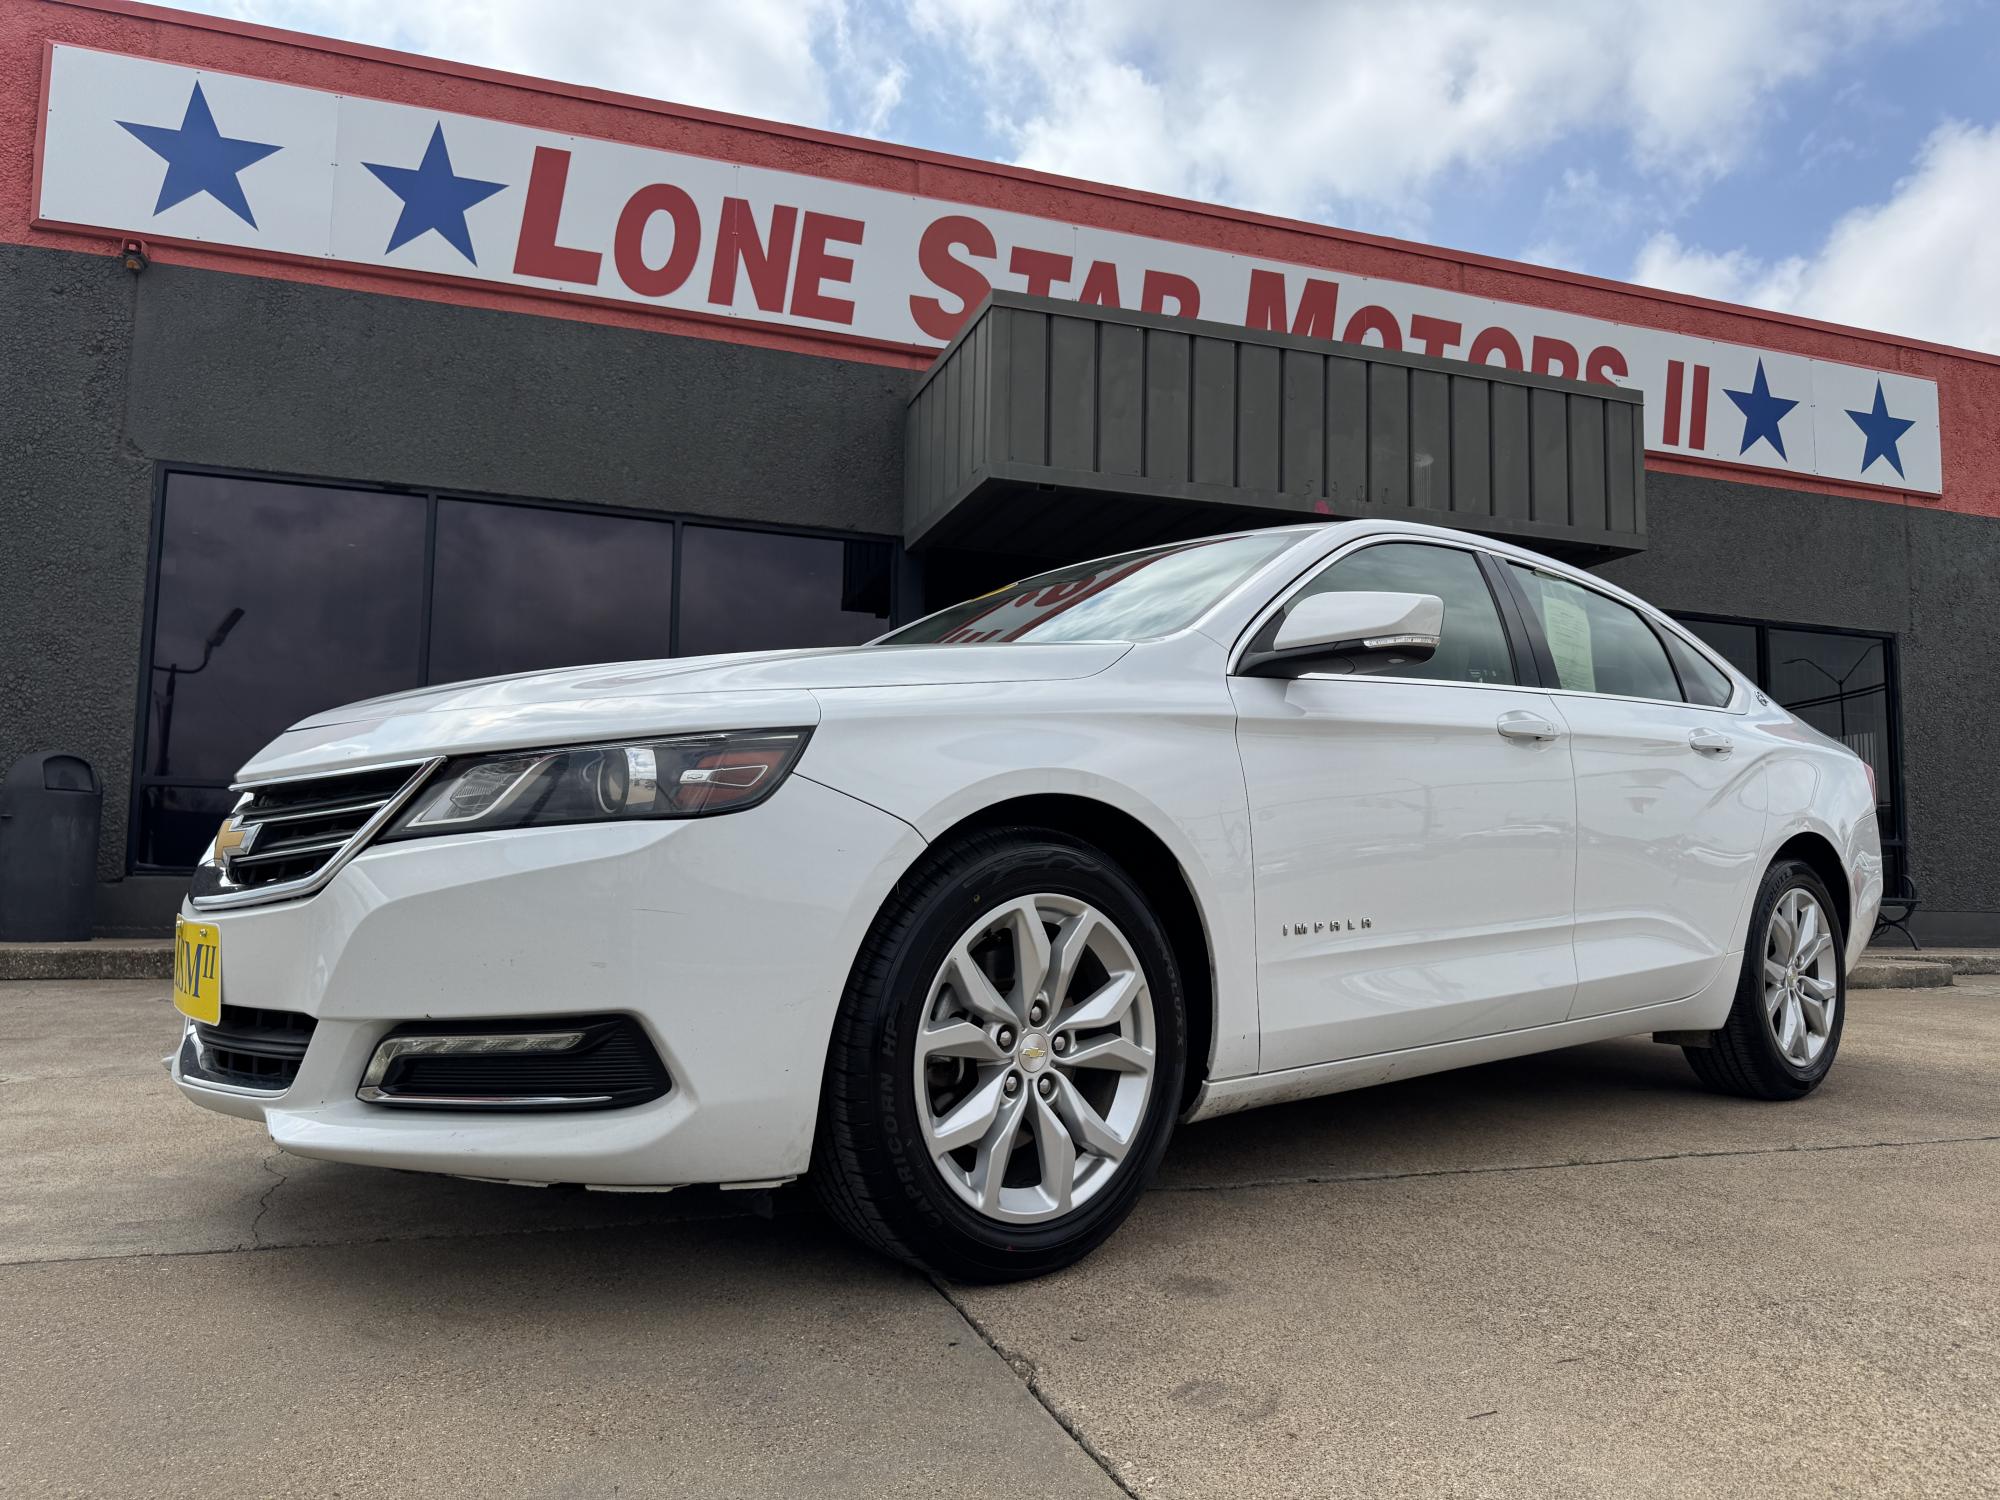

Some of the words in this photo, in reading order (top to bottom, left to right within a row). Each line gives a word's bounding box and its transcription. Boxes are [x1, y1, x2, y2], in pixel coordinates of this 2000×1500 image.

[514, 145, 865, 326] LONE
[1663, 360, 1710, 450] II
[1282, 917, 1372, 936] IMPALA
